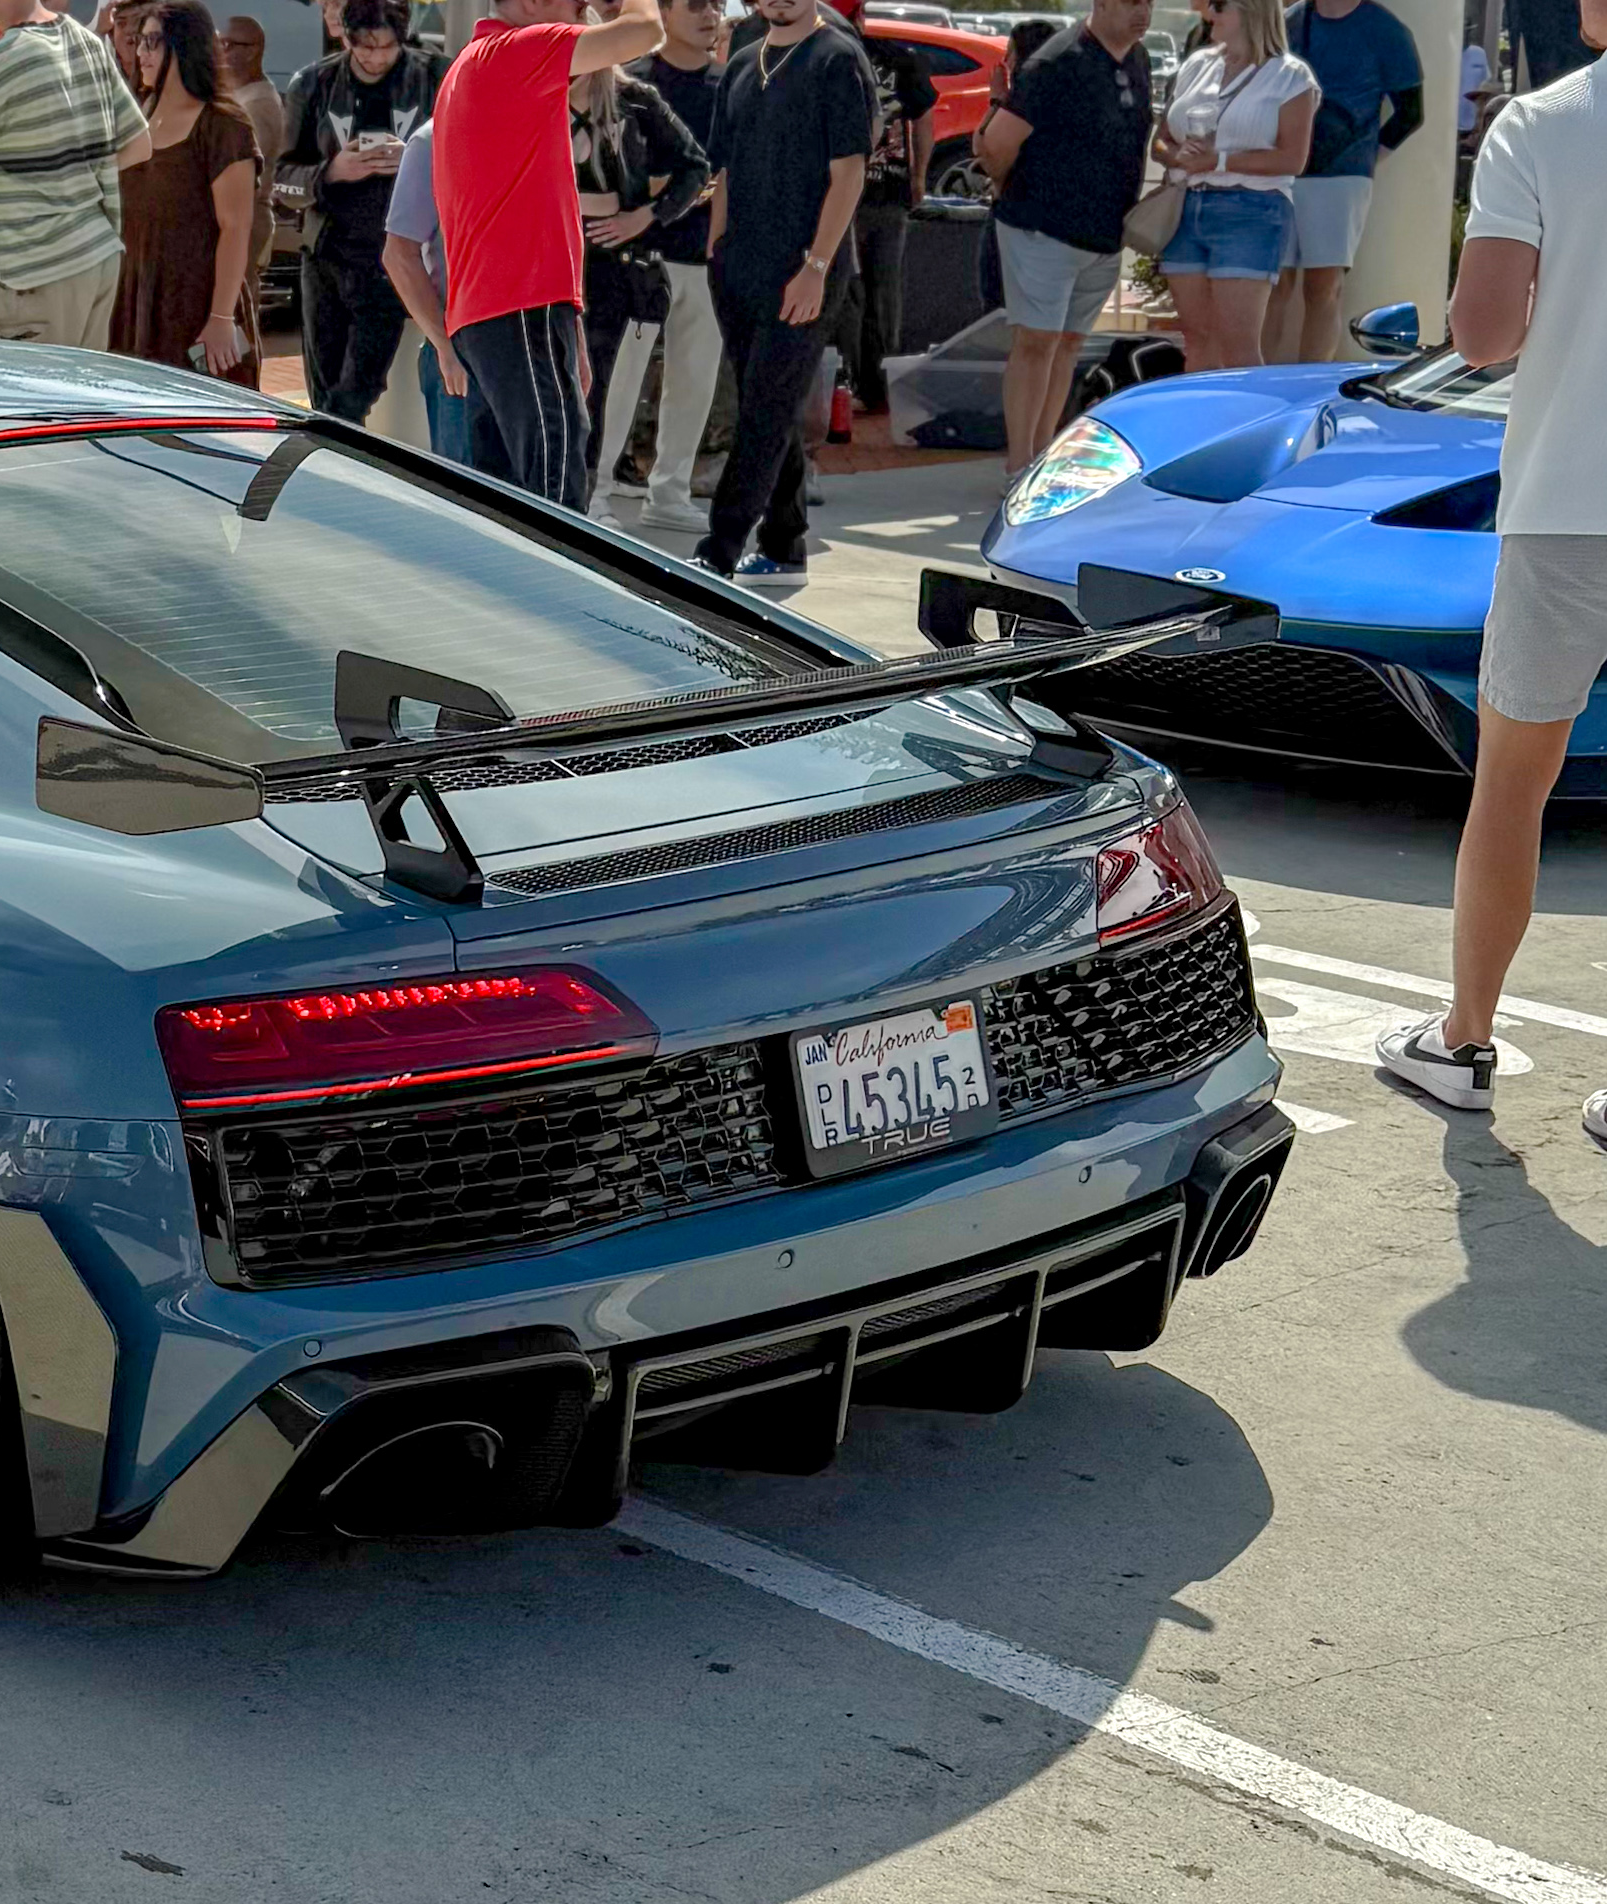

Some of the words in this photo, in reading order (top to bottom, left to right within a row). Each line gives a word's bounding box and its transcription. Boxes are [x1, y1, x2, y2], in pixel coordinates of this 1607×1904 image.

[804, 1042, 829, 1066] JAN
[835, 1025, 949, 1067] California
[842, 1054, 959, 1136] 45345
[860, 1117, 951, 1155] TRUE
